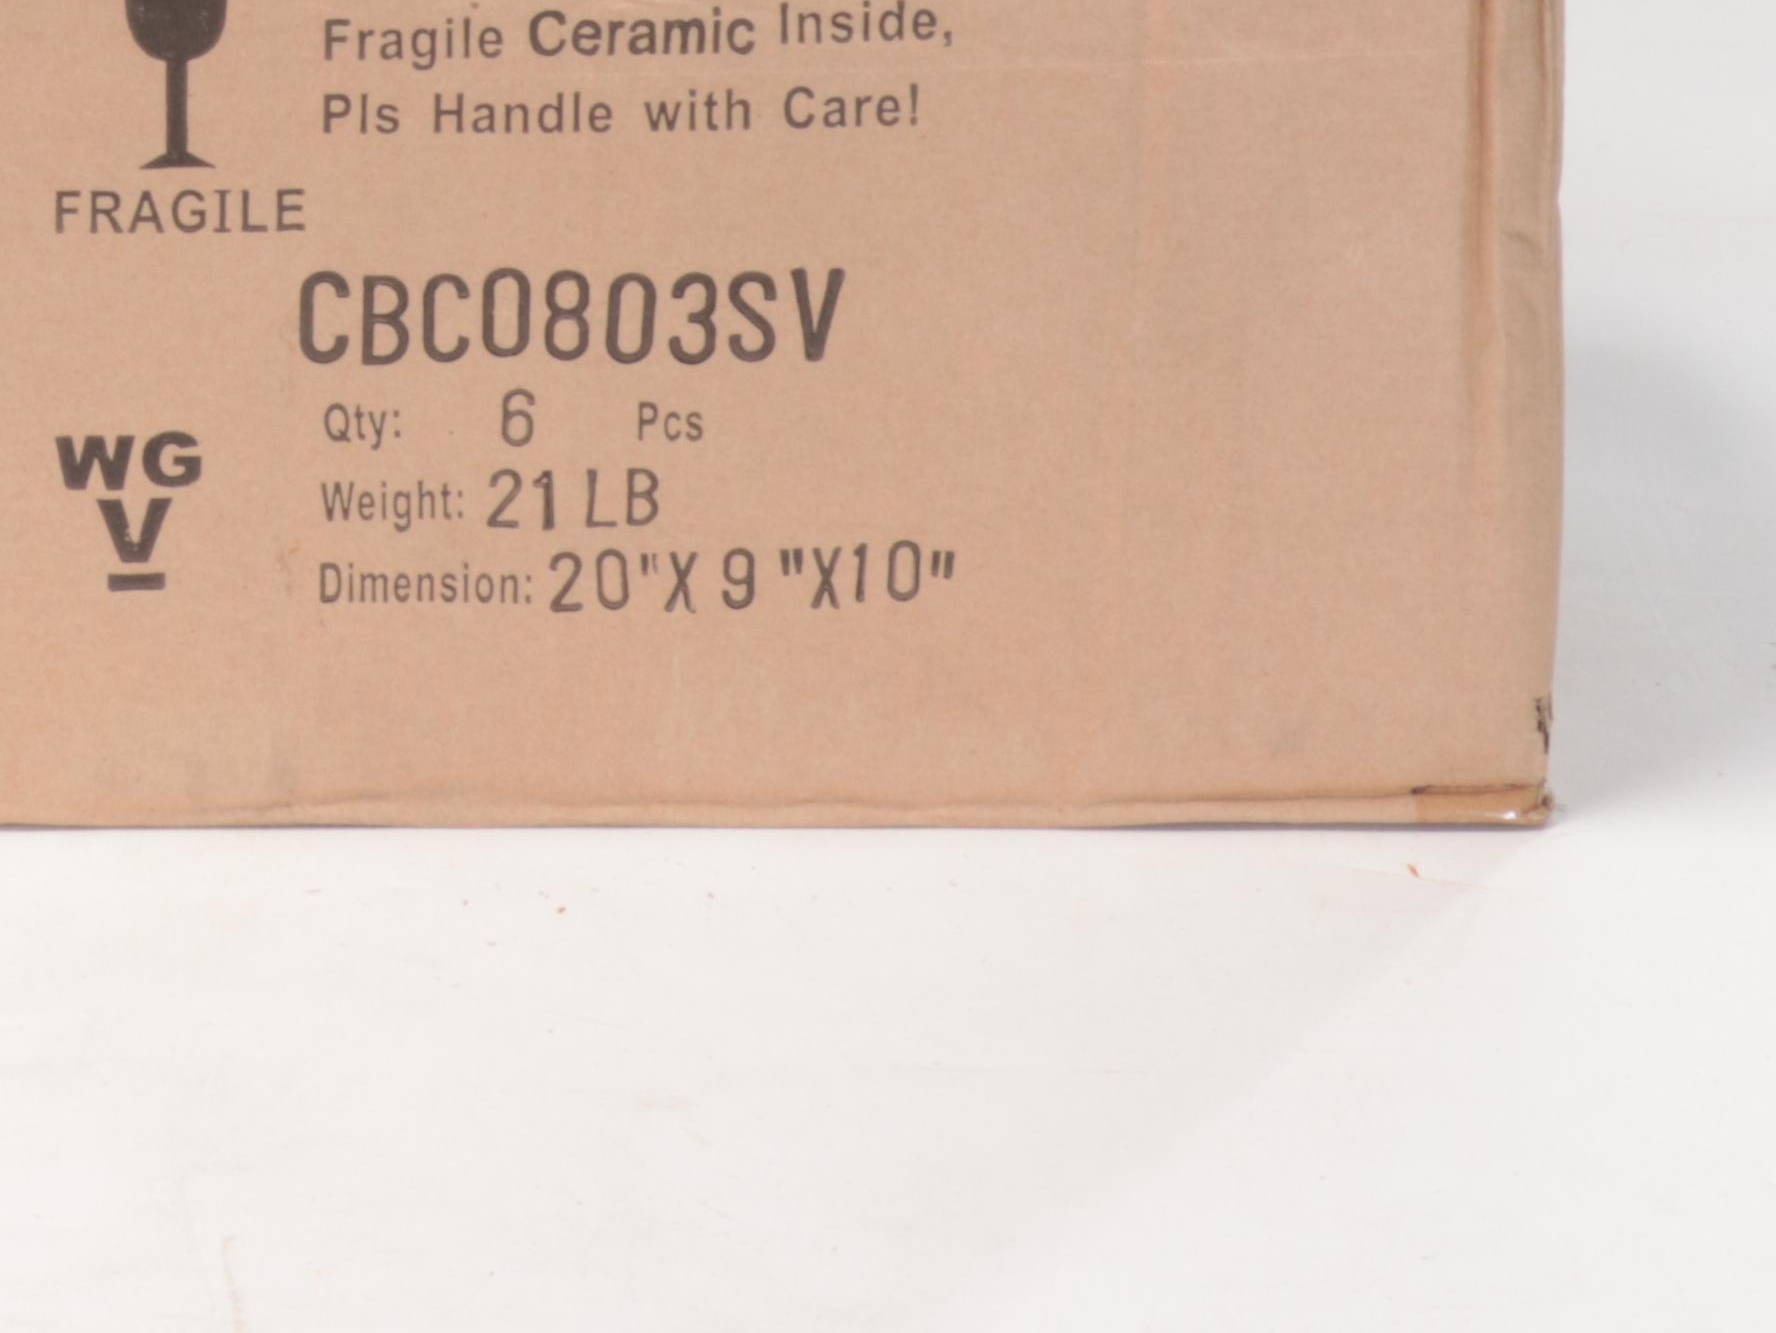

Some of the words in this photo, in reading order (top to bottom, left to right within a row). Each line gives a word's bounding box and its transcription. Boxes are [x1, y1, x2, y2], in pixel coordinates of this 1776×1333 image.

[324, 16, 504, 71] Fragile
[528, 5, 755, 57] Ceramic
[322, 92, 400, 135] Pls
[433, 91, 613, 134] Handle
[643, 88, 751, 132] with
[783, 82, 919, 130] Care!
[55, 188, 306, 234] FRAGILE
[298, 266, 846, 366] CBC0803SV
[323, 402, 401, 451] Qty:
[500, 387, 536, 448] 6
[637, 400, 704, 442] Pcs
[55, 430, 202, 491] WG
[96, 497, 173, 564] V
[320, 479, 464, 534] Weight:
[486, 468, 556, 532] 21
[585, 467, 660, 529] LB
[319, 561, 532, 604] Dimension:
